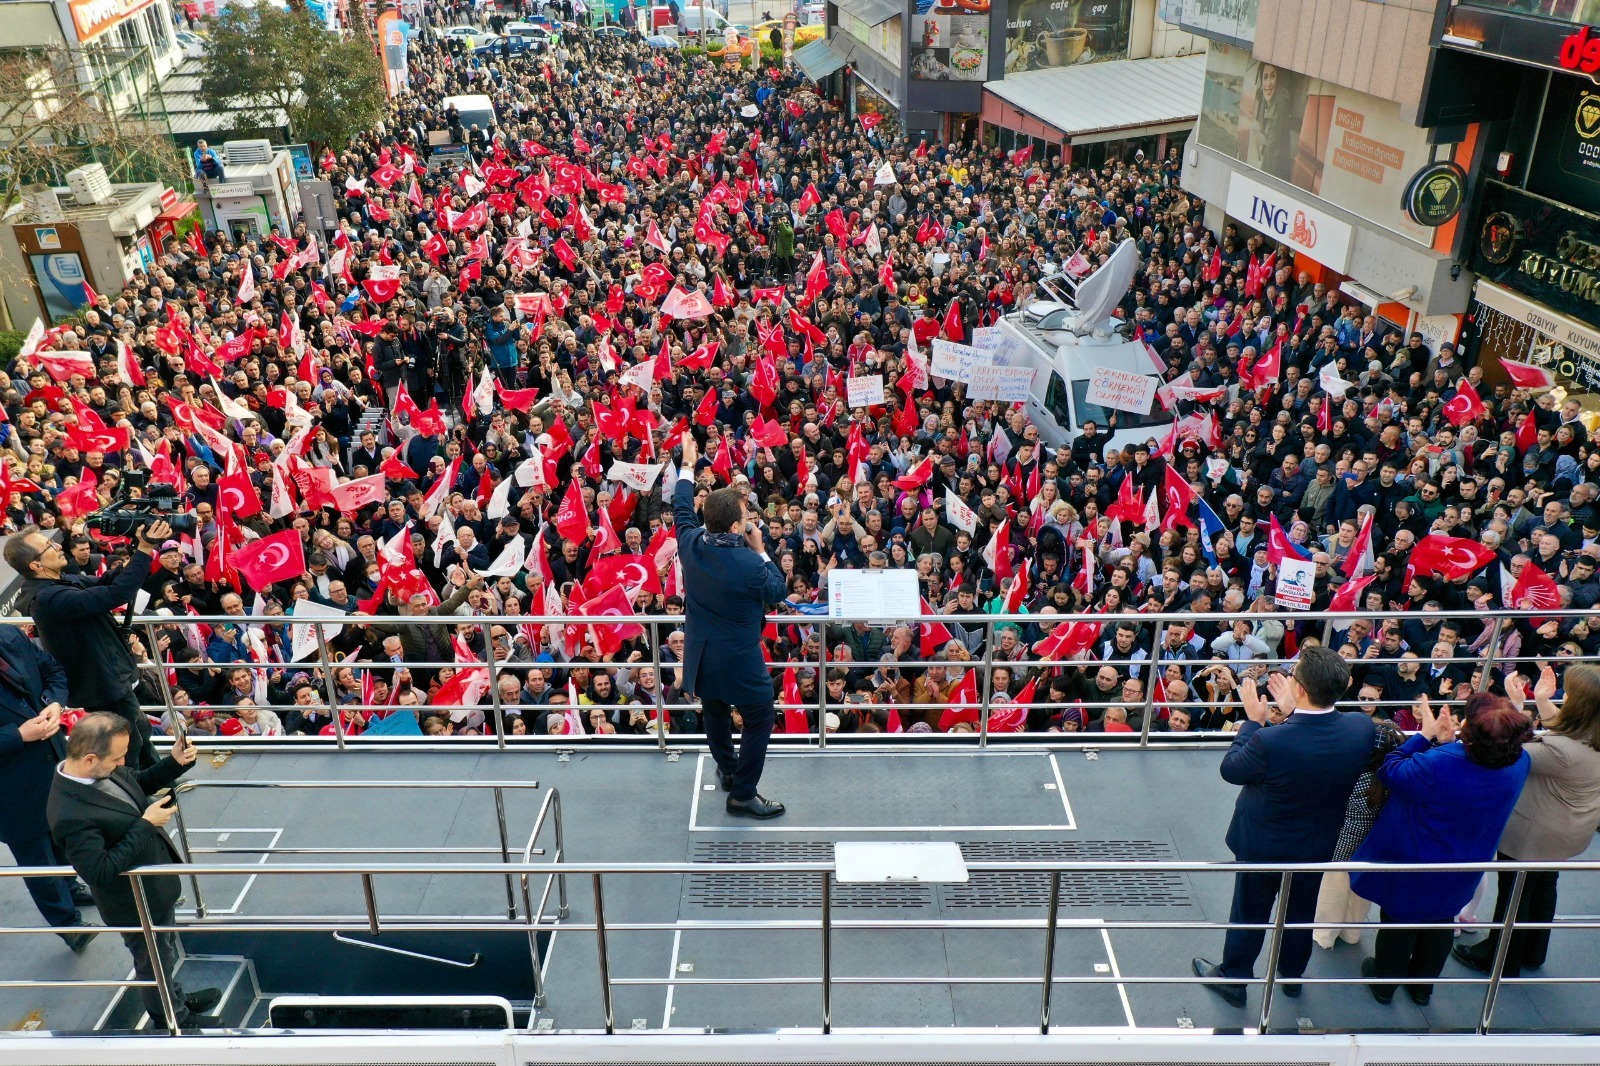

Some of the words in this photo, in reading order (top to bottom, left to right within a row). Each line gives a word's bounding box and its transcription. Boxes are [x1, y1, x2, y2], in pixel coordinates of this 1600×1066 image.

[1051, 0, 1069, 10] cafe
[1092, 4, 1108, 15] çay
[1007, 19, 1032, 29] kahve
[1250, 195, 1289, 236] ING
[1526, 309, 1558, 335] ÖZBIYIK
